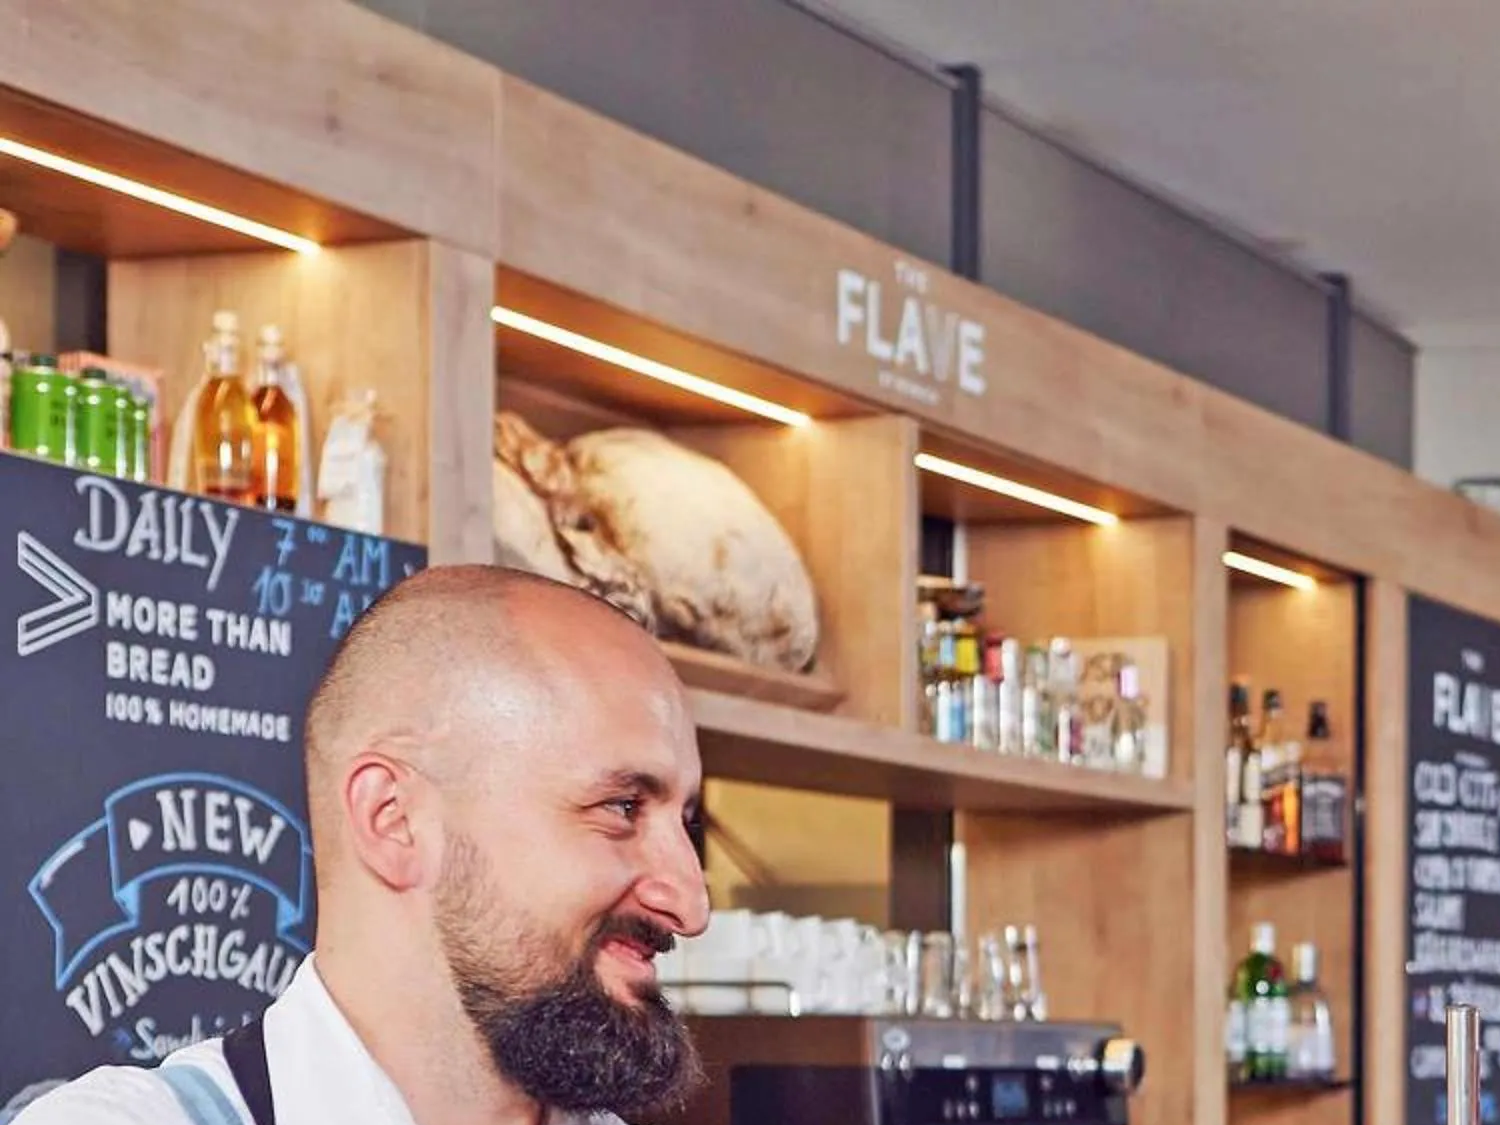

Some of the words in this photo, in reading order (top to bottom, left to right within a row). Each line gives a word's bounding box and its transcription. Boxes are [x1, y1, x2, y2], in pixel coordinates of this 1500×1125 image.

[836, 269, 986, 396] FLAVE
[74, 475, 240, 591] DAILY
[331, 533, 390, 590] AM
[106, 590, 198, 641] MORE
[206, 607, 293, 657] THAN
[106, 640, 216, 691] BREAD
[105, 692, 164, 726] 100%
[169, 702, 292, 743] HOMEMADE
[156, 788, 287, 865] NEW
[166, 876, 252, 920] 100%
